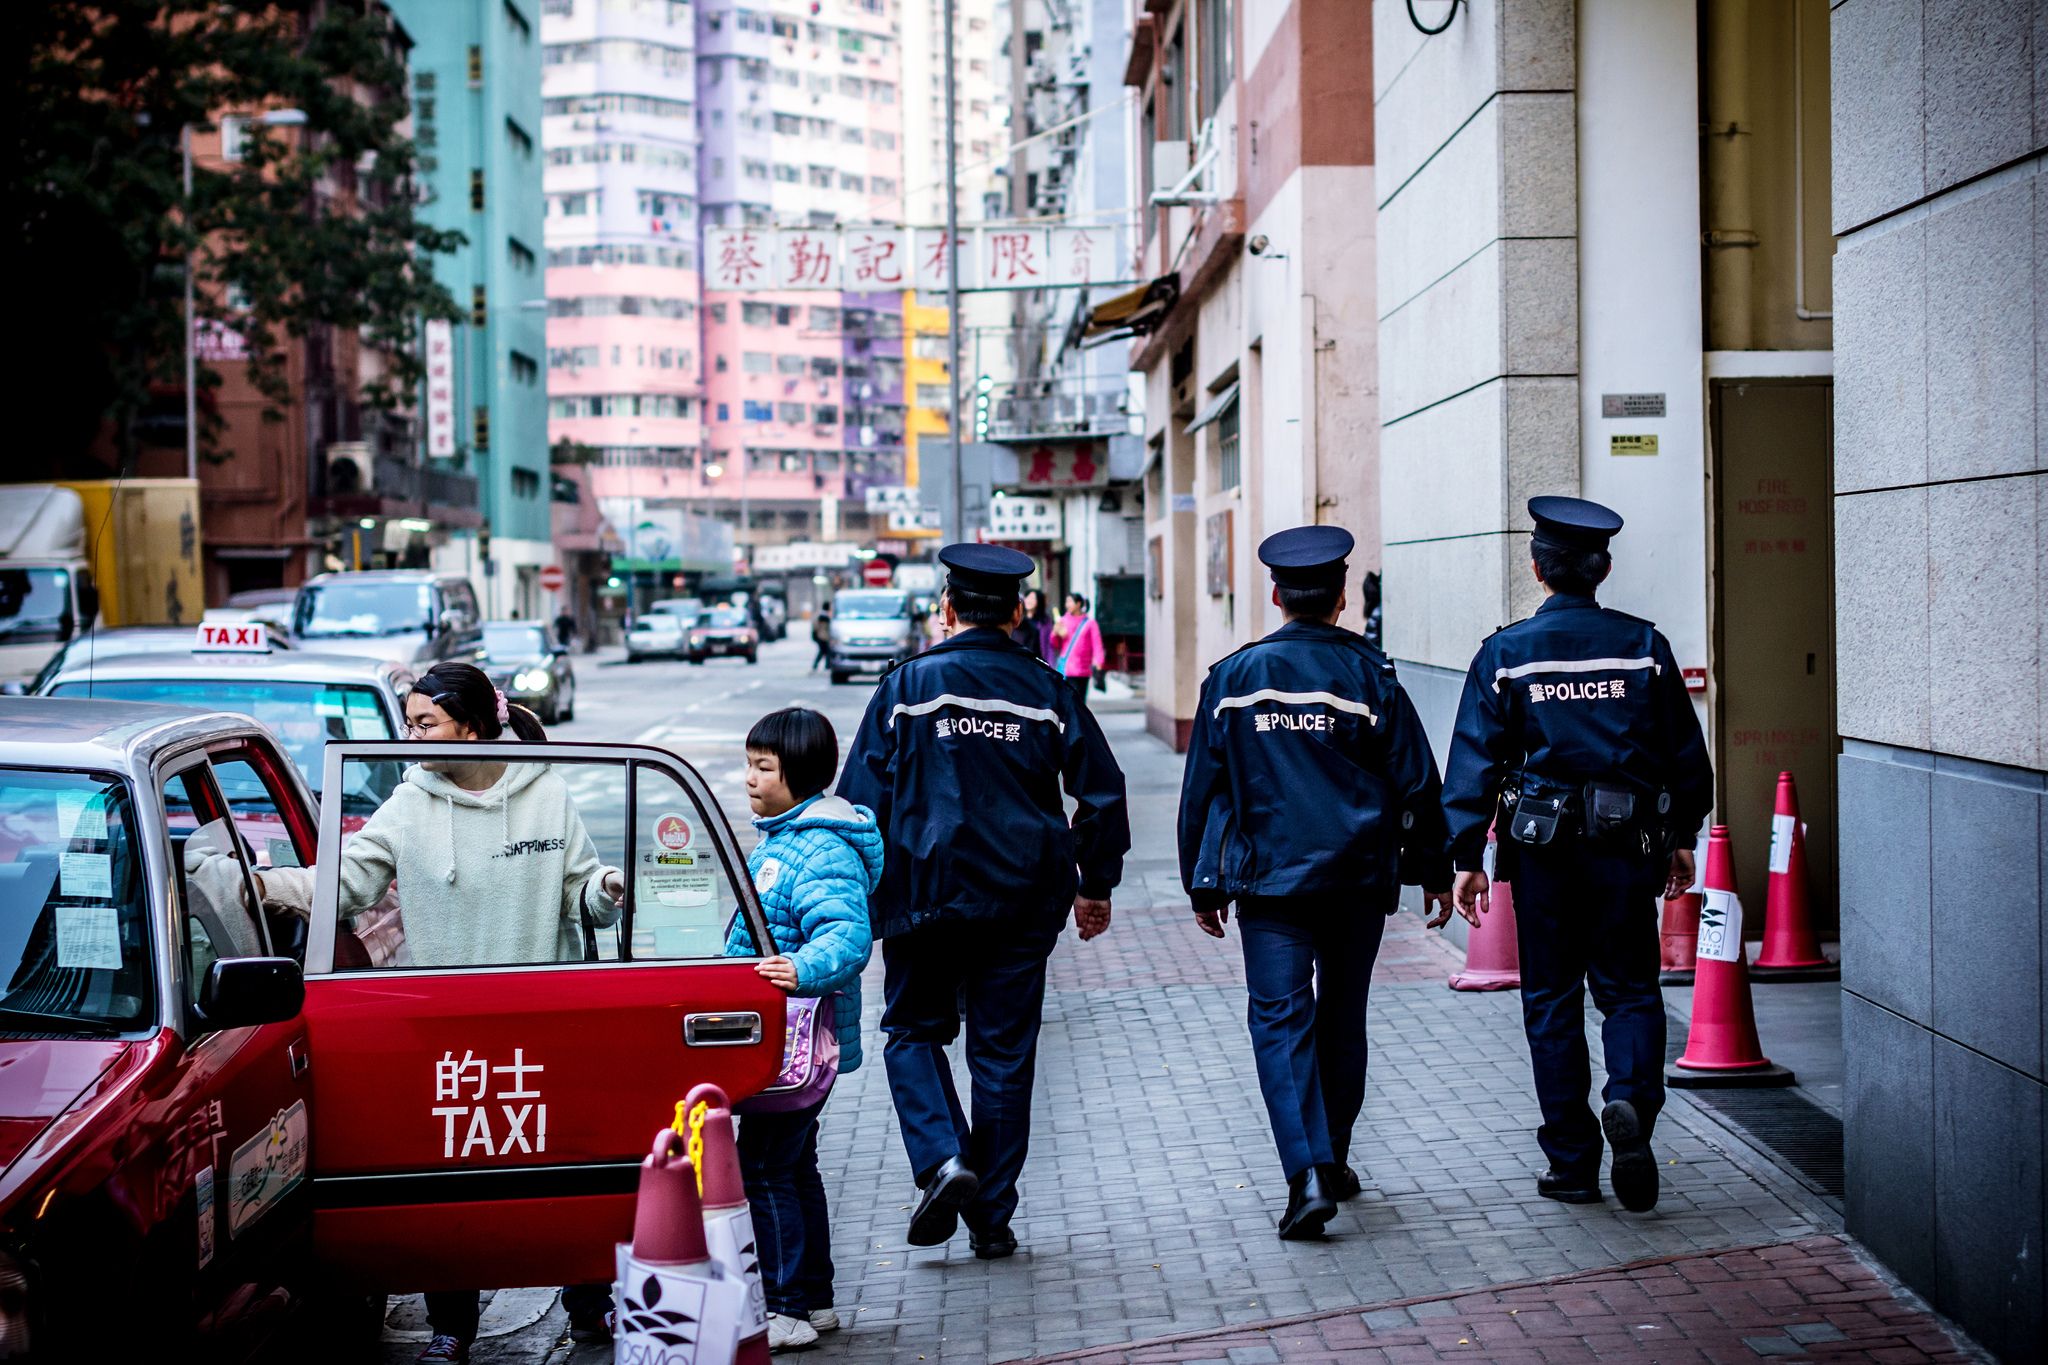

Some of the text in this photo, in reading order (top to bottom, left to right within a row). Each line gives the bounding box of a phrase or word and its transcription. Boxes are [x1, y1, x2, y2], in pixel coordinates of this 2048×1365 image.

[203, 627, 259, 645] TAXI
[436, 1048, 544, 1101] 的士
[432, 1104, 547, 1158] TAXI
